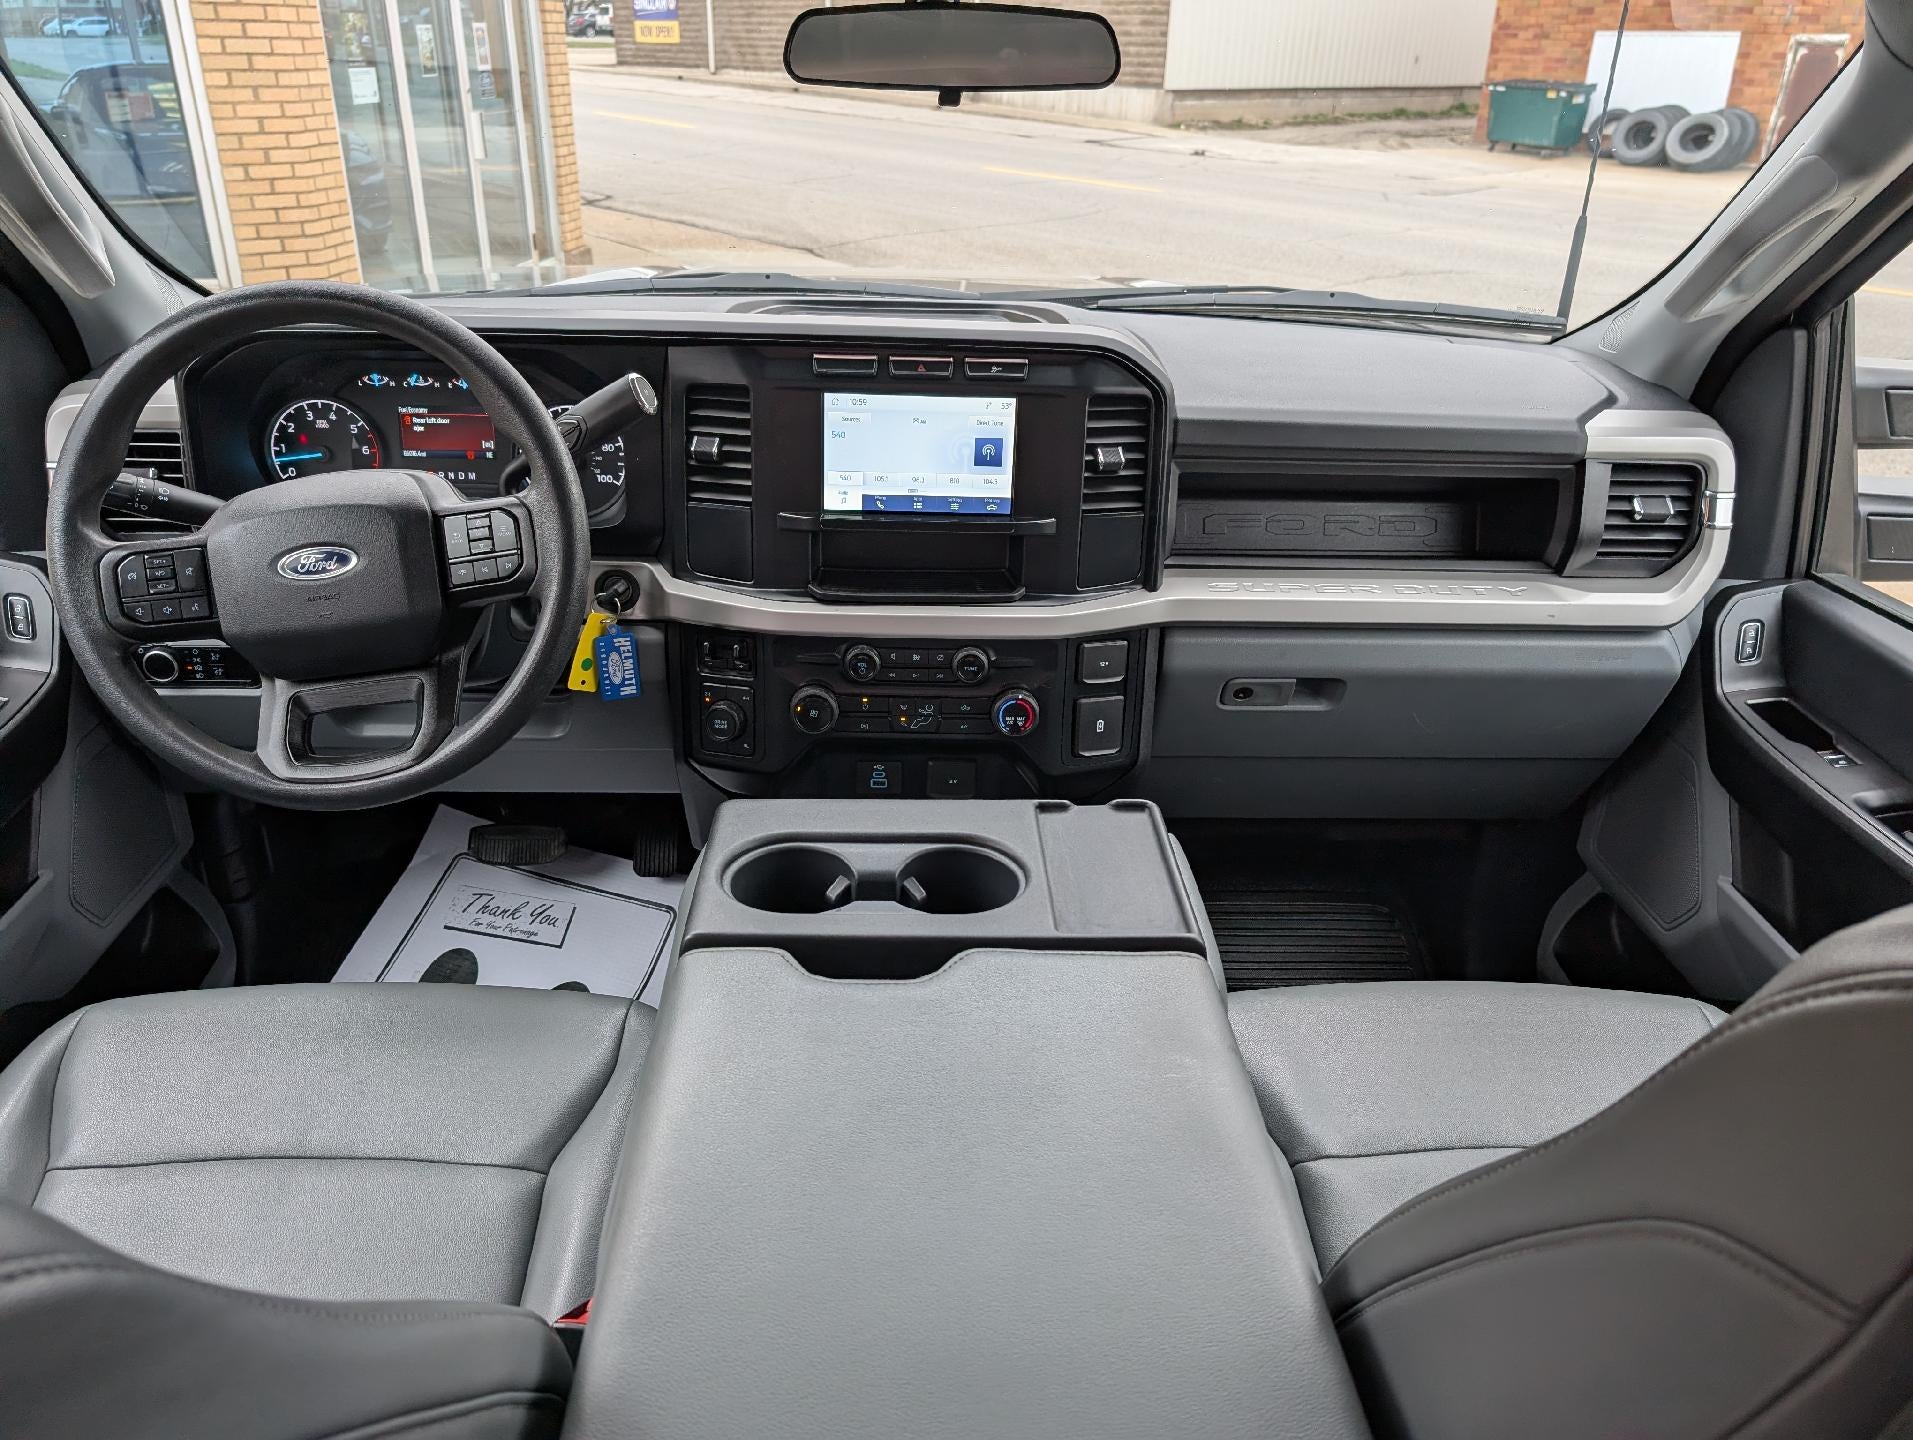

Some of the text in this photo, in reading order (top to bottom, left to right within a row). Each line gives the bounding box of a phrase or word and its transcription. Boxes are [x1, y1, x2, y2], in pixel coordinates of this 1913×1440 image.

[306, 410, 314, 420] 3
[329, 411, 337, 420] 4
[287, 423, 295, 433] 2
[350, 424, 358, 434] 5
[831, 430, 846, 439] 540
[280, 443, 286, 453] 1
[361, 445, 370, 455] 6
[601, 443, 615, 452] 80
[288, 467, 296, 477] 0
[448, 472, 455, 480] N
[458, 472, 465, 480] D
[468, 472, 476, 480] M
[596, 474, 614, 483] 100
[1202, 513, 1438, 538] FORD
[297, 553, 338, 573] Ford
[1207, 582, 1528, 597] SUPER DUTY
[613, 636, 637, 696] HELMUTH
[462, 892, 560, 929] Thank You
[469, 917, 538, 938] For Your Patronage
